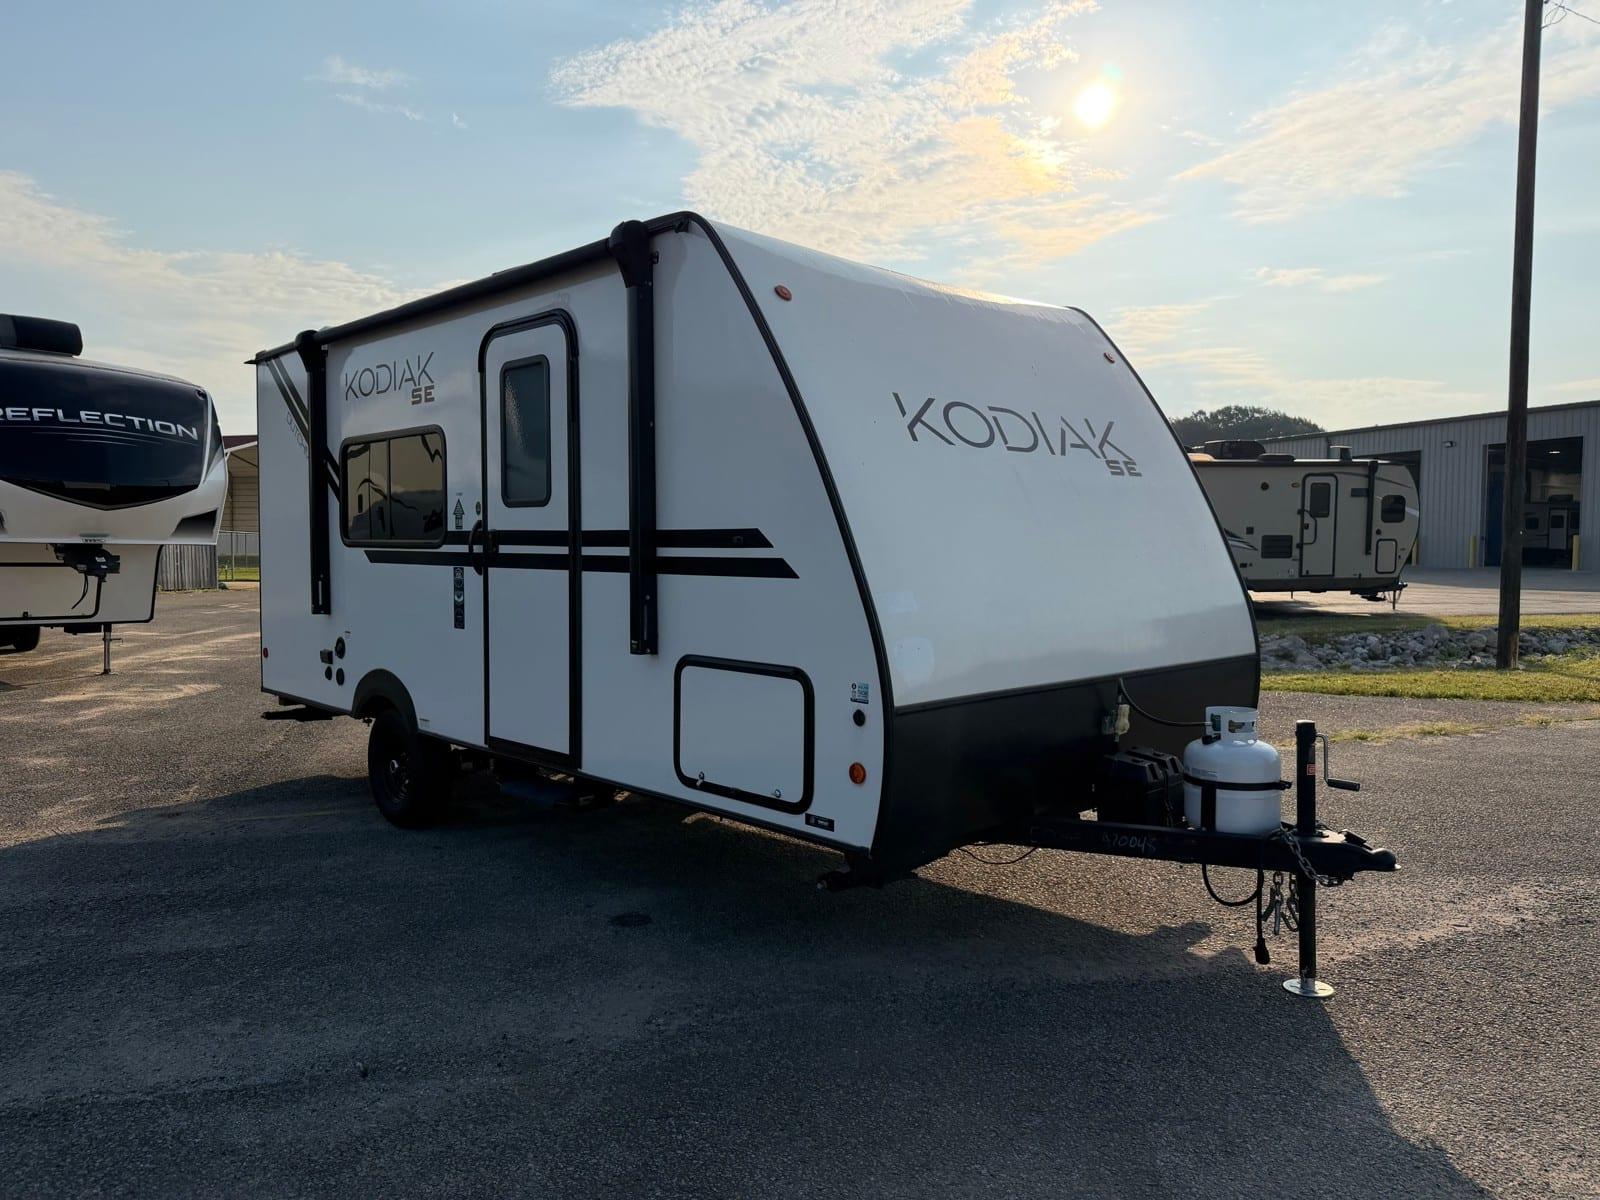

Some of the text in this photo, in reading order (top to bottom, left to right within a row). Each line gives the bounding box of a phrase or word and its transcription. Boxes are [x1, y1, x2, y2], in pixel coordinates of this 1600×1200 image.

[345, 351, 434, 400] KODIAK
[411, 385, 435, 405] SE
[0, 407, 198, 441] EFLECTION
[892, 392, 1135, 461] KODIAK
[1105, 460, 1142, 477] SE
